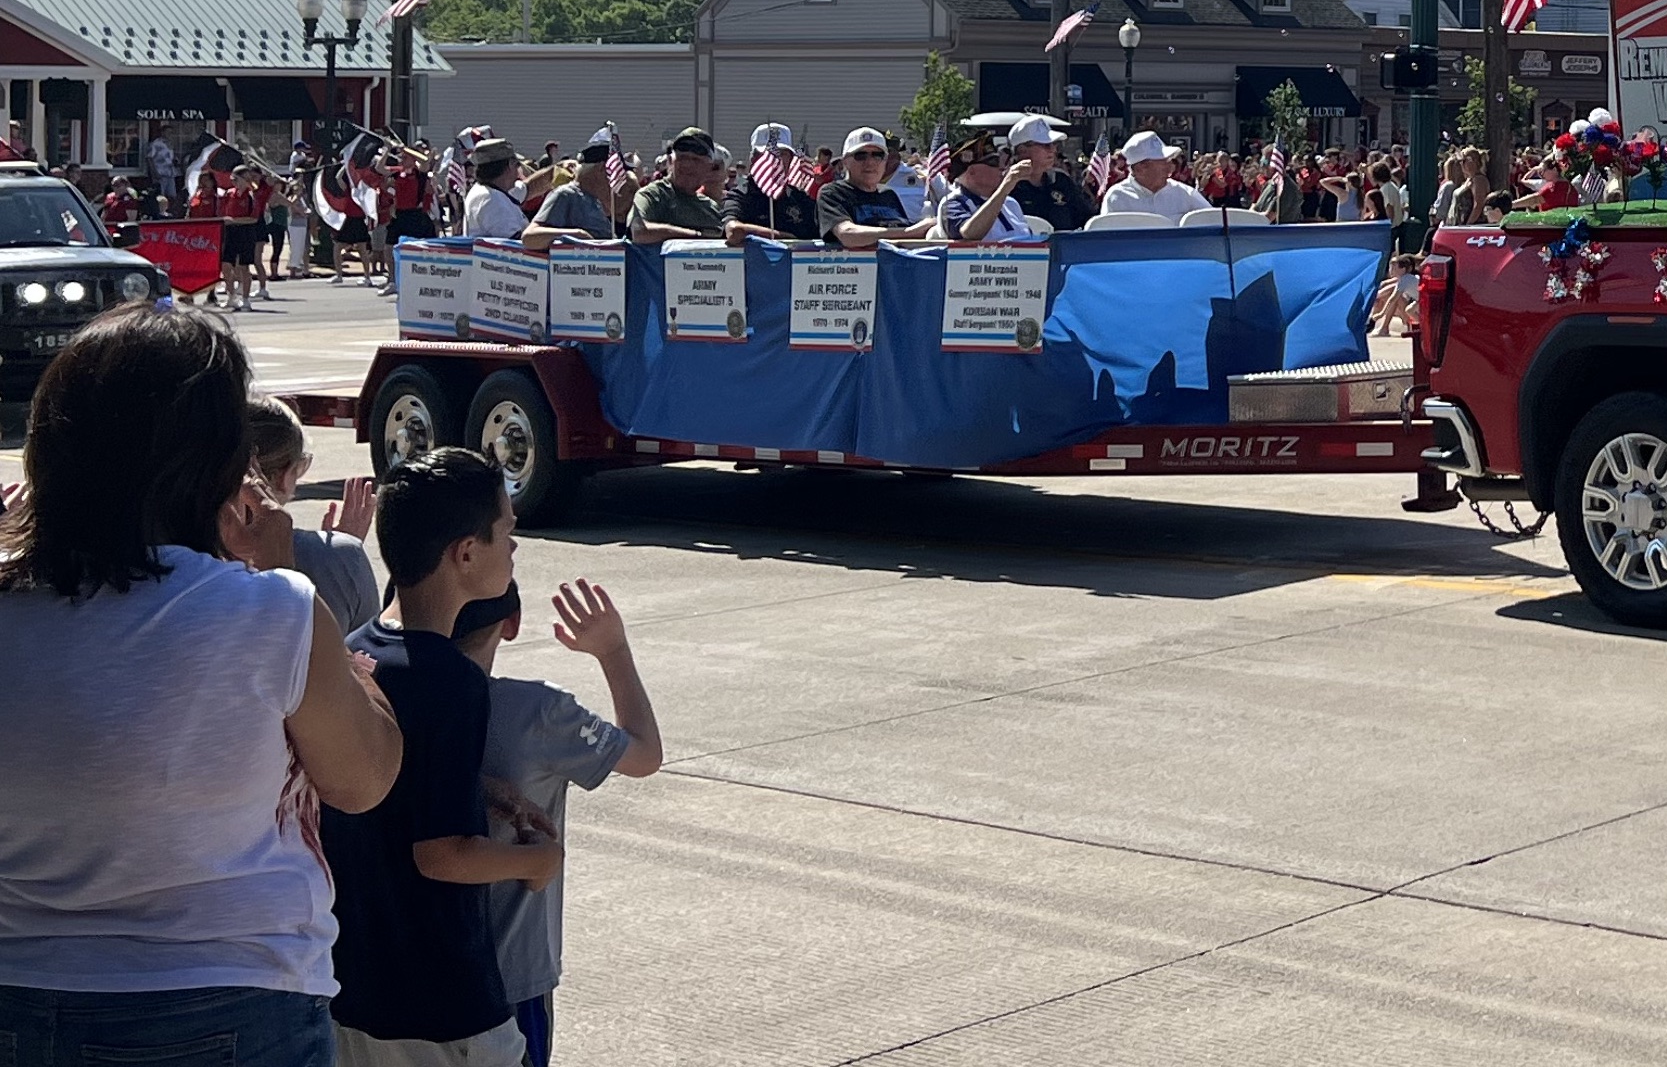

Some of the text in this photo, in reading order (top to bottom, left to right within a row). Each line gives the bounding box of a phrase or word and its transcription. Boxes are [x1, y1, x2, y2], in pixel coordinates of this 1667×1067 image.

[136, 109, 204, 120] SOLIA SPA
[1313, 107, 1346, 117] LUXURY
[553, 264, 585, 275] Richard
[692, 280, 717, 290] ARMY
[968, 277, 993, 286] ARMY
[808, 284, 858, 295] AIR FORCE
[677, 295, 725, 306] SPECIALIST
[794, 299, 872, 311] STAFF SERGEANT
[963, 306, 997, 316] KOREAN
[1160, 436, 1300, 458] MORITZ
